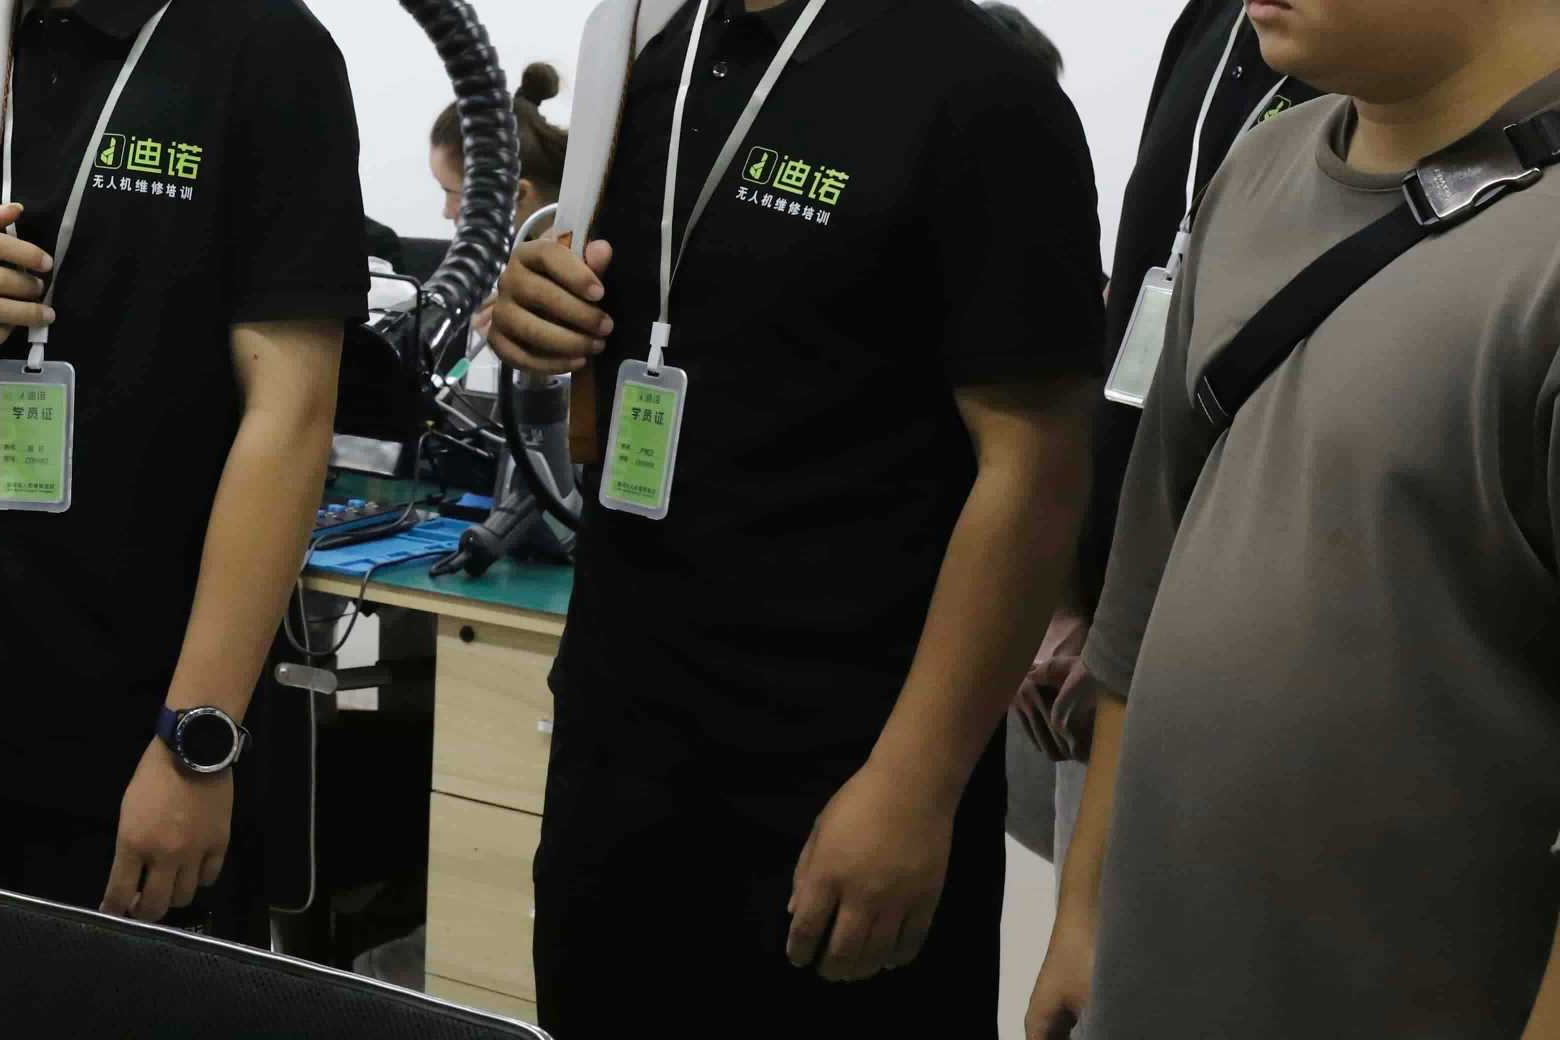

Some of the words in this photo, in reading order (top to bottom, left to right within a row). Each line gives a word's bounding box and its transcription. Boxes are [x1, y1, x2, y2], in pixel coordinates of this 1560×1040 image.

[126, 135, 203, 180] 迪诺
[91, 174, 194, 201] 无人机维修培训
[772, 154, 850, 206] 迪诺
[735, 185, 831, 226] 无人机维修培训
